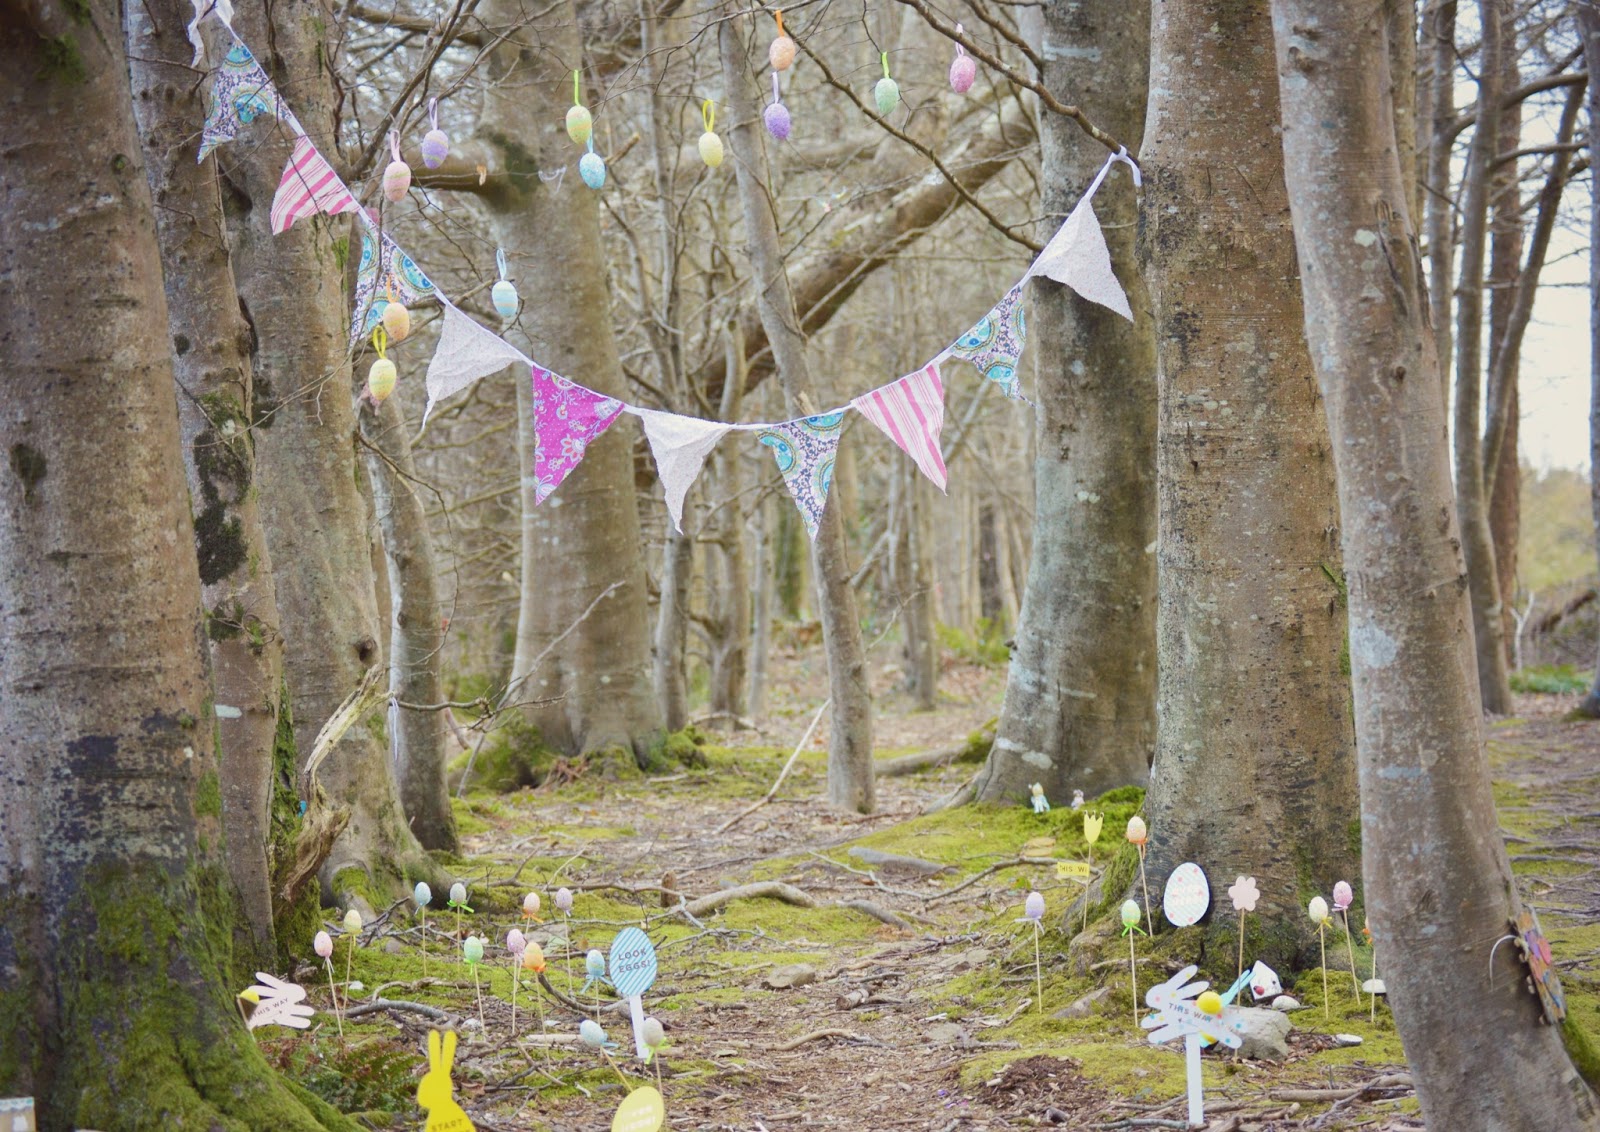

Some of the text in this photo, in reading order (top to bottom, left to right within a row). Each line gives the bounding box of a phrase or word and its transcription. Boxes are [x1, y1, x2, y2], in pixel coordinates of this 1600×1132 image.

[618, 947, 647, 961] LOOK
[619, 959, 651, 973] EGGS!
[253, 997, 289, 1018] THIS WAY
[1168, 1002, 1214, 1022] THIS WAY
[431, 1118, 463, 1132] START
